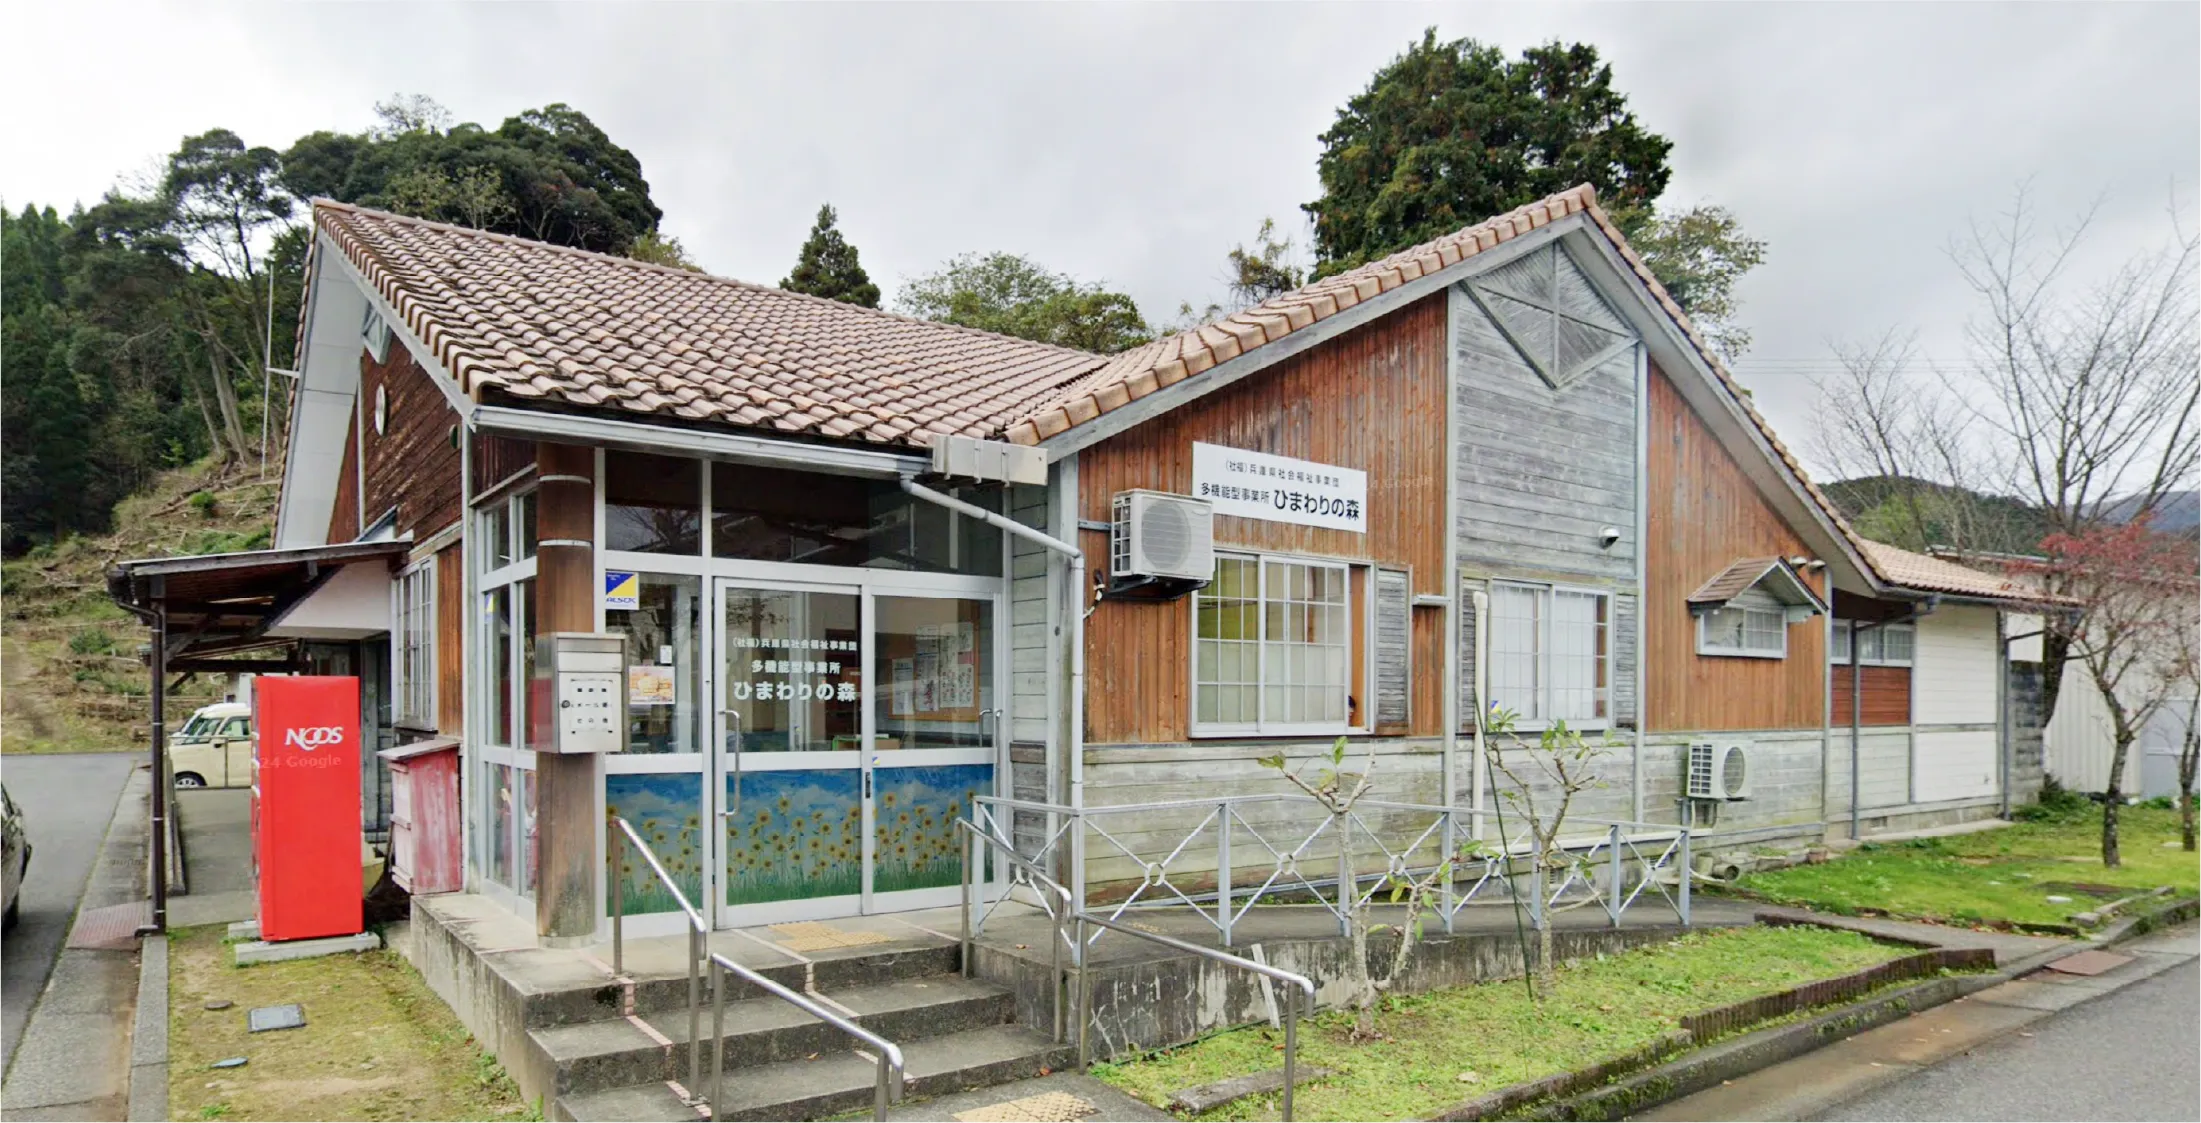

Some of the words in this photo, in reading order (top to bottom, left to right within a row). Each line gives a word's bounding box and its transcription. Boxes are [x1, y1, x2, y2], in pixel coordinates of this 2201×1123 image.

[1201, 482, 1270, 504] 多機能型事業所
[1274, 489, 1360, 522] ひまわりの森
[752, 660, 841, 674] 多機能型事業所
[734, 681, 857, 702] ひまわりの森
